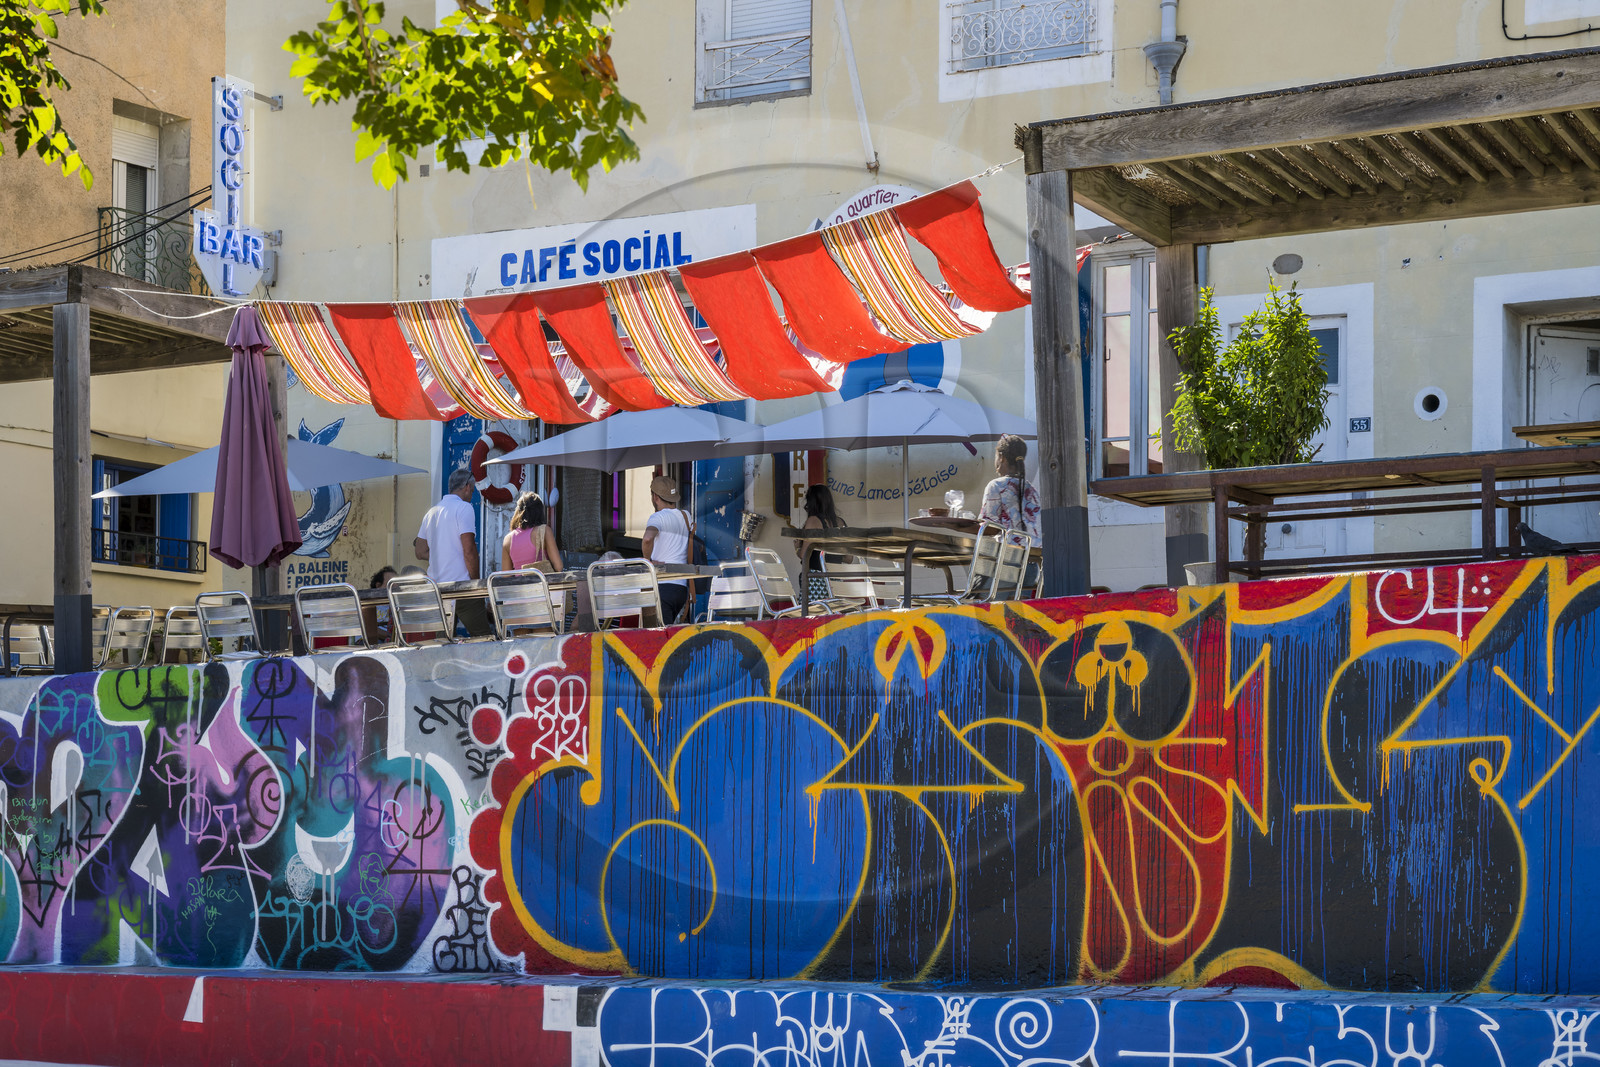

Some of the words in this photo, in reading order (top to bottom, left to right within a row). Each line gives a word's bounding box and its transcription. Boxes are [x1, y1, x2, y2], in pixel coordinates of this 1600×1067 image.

[220, 87, 244, 297] SOCIAL
[199, 219, 264, 270] BAR
[500, 238, 576, 287] CAFÉ
[1352, 419, 1367, 431] 35
[857, 481, 901, 501] Lance
[299, 560, 348, 574] BALEINE
[295, 573, 348, 589] PROUST
